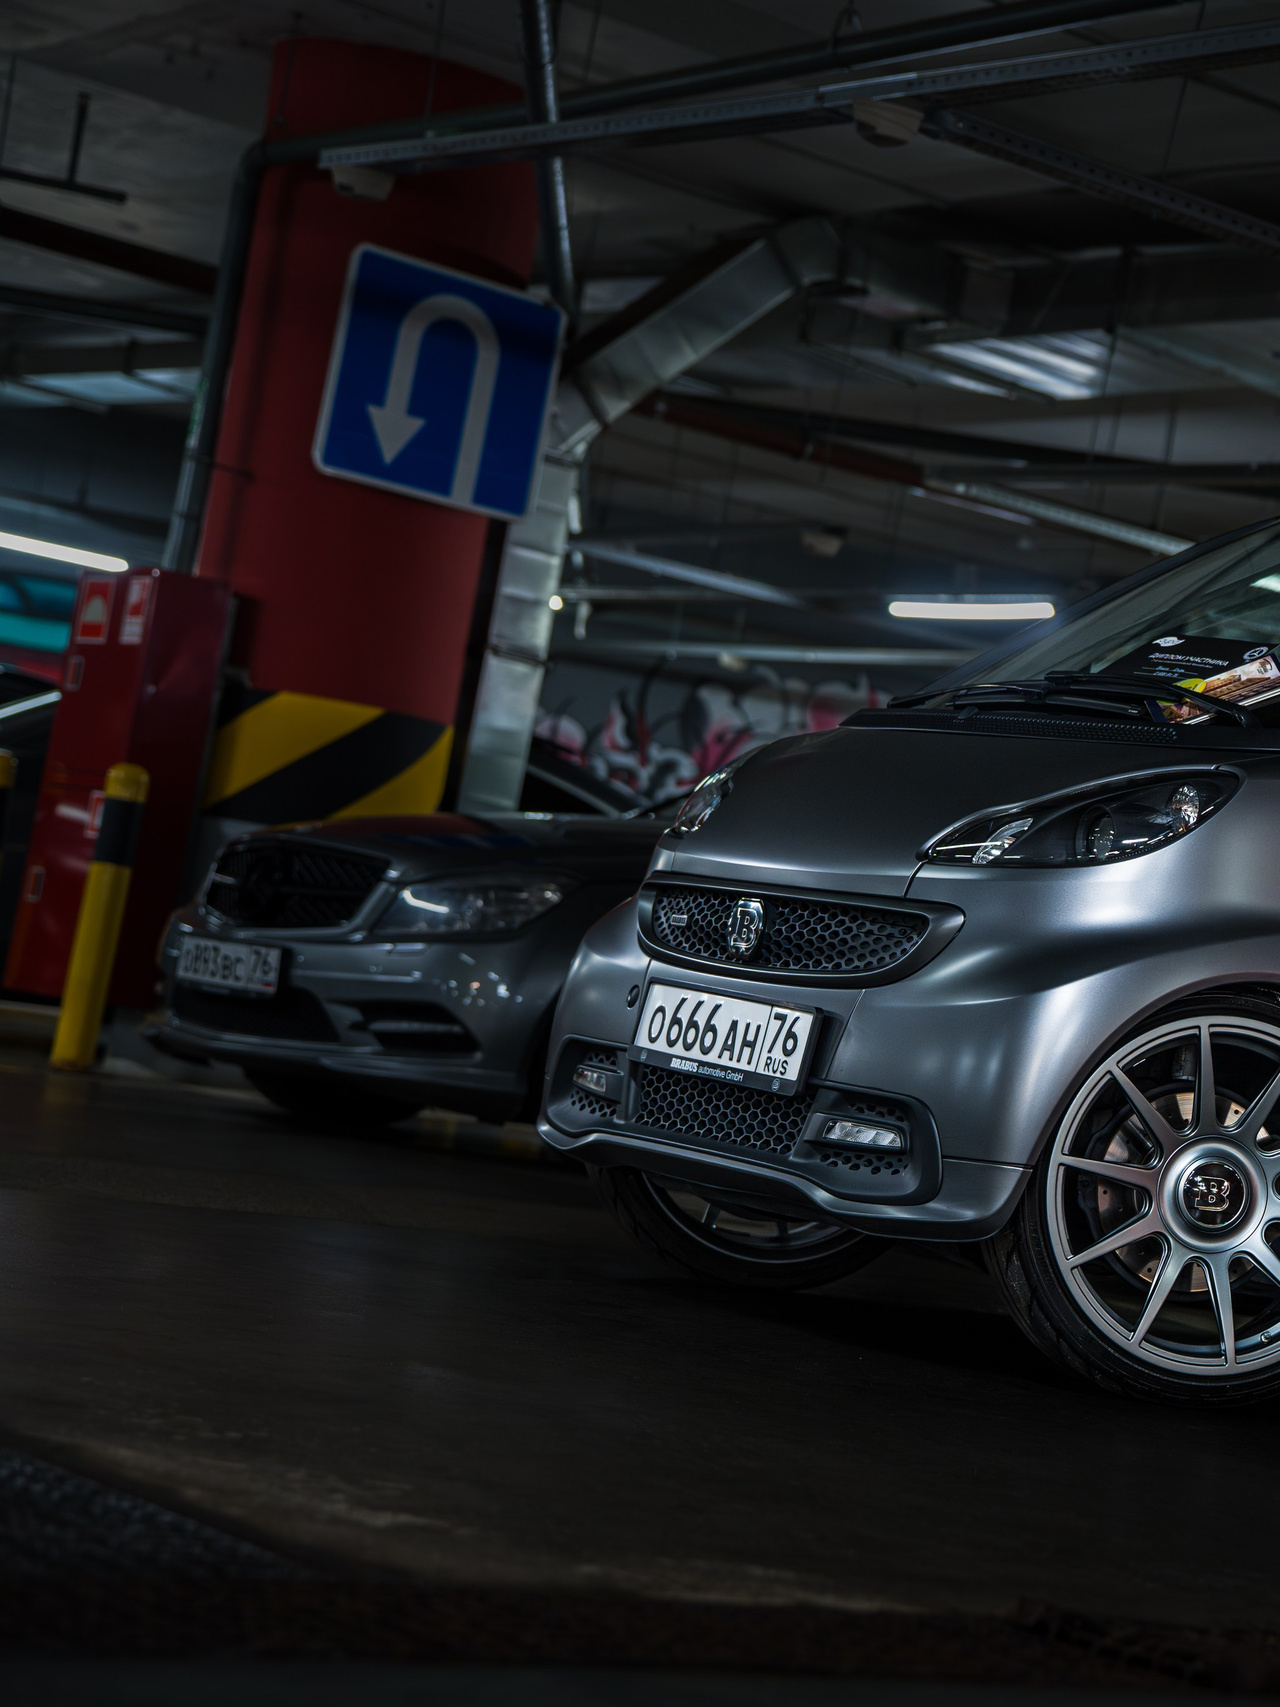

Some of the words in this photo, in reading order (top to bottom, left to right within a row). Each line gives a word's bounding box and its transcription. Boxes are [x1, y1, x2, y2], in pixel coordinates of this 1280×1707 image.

[767, 1012, 801, 1057] 76
[670, 1057, 699, 1073] BRABUS
[698, 1065, 726, 1079] automotive
[725, 1069, 744, 1082] GmbH
[763, 1056, 789, 1076] RUS
